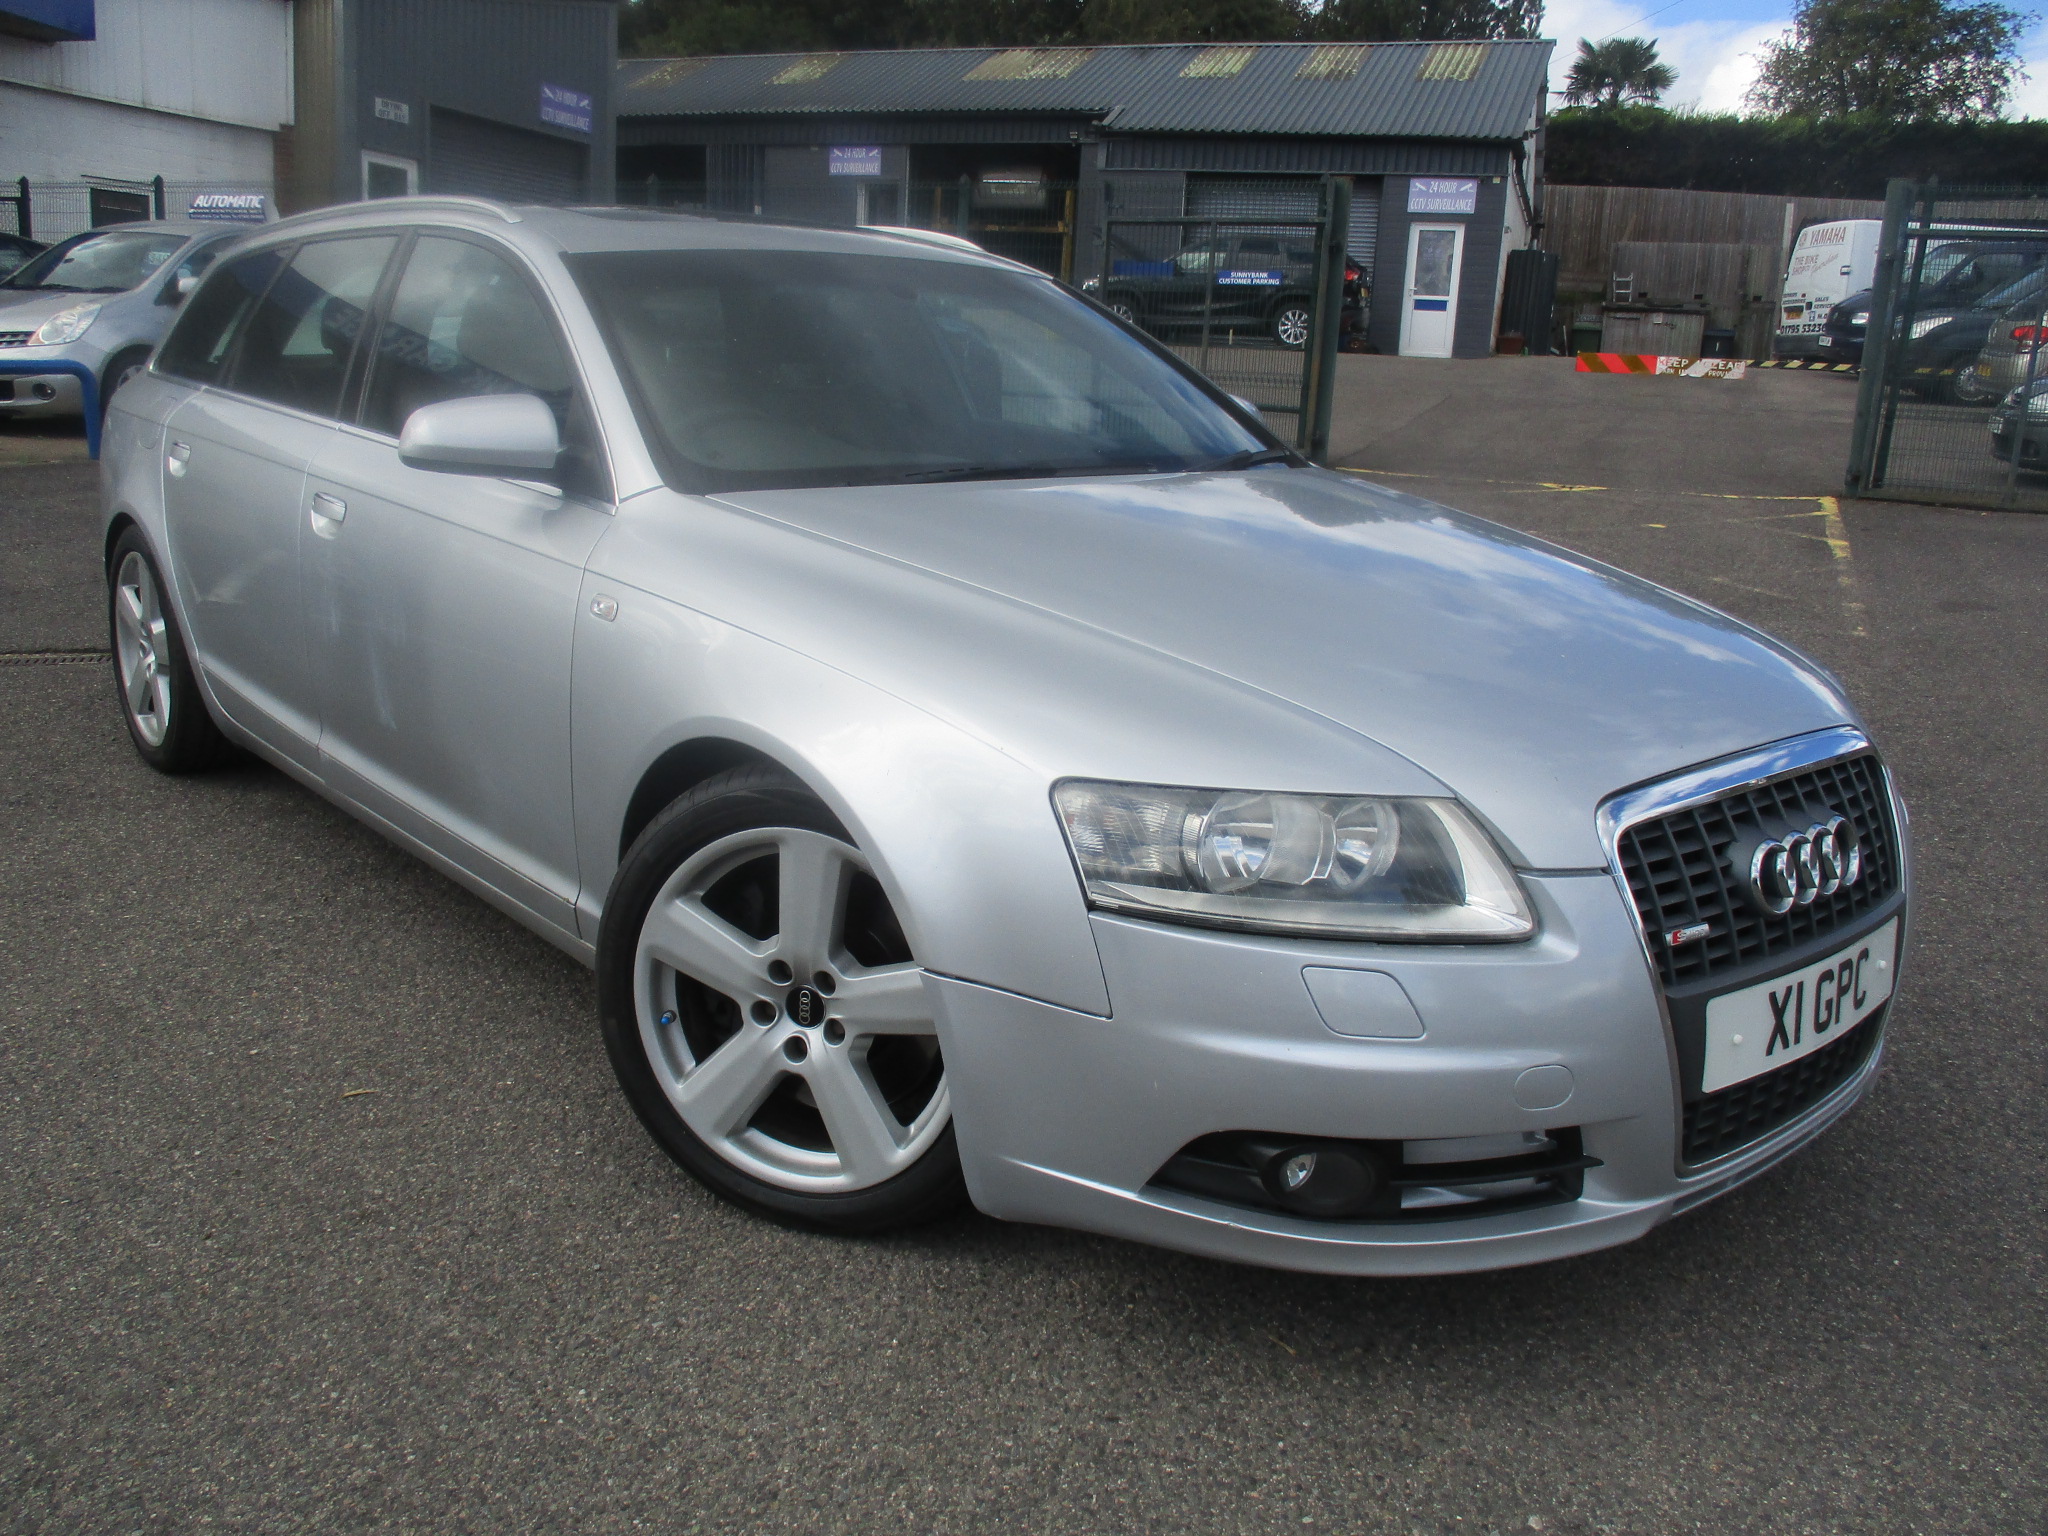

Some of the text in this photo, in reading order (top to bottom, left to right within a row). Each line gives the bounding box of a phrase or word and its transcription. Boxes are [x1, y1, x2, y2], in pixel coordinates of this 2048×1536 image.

[1429, 181, 1458, 193] 24 HOUR
[194, 195, 265, 208] AUTOMATIC
[1410, 198, 1472, 211] CCTV SURVEILLANCE
[1810, 227, 1846, 245] YAMAHA
[1780, 325, 1800, 335] 01795
[1813, 947, 1869, 1034] GPC
